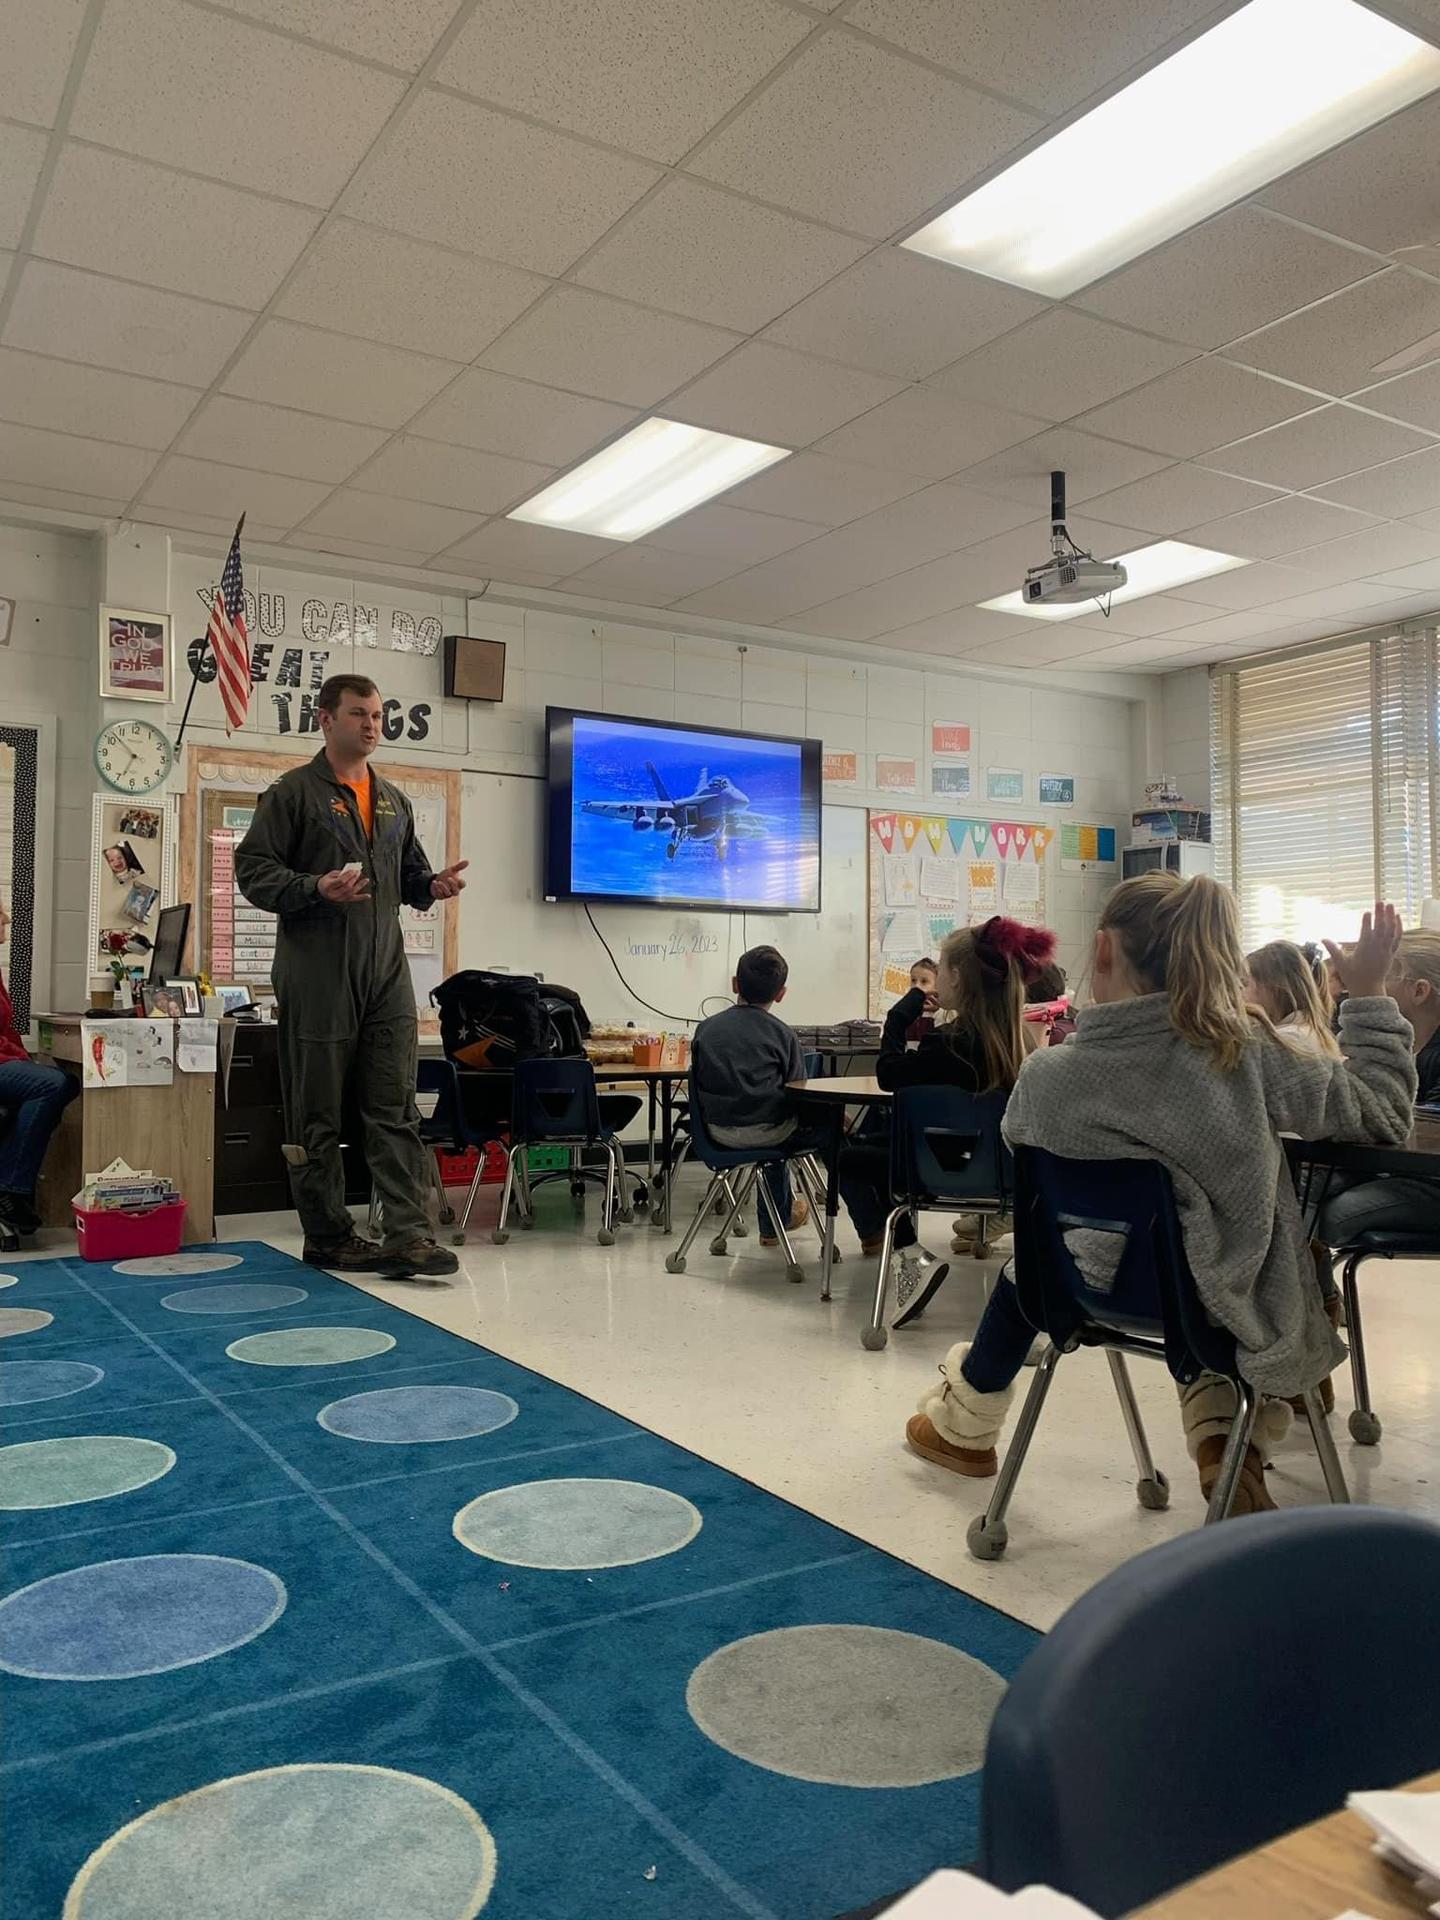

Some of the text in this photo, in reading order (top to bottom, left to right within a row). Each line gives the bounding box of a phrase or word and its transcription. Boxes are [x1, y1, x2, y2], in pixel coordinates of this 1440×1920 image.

[127, 622, 146, 638] IN
[302, 599, 378, 649] CAN
[391, 609, 443, 657] DO
[112, 633, 154, 651] GOD
[122, 648, 151, 665] WE
[187, 637, 330, 690] GEAT
[271, 691, 432, 742] THGS
[119, 728, 125, 737] 11
[132, 725, 140, 735] 12
[107, 736, 116, 746] 10
[156, 742, 163, 751] 2
[102, 748, 108, 757] 9
[160, 756, 166, 765] 3
[105, 762, 112, 771] 8
[115, 773, 122, 781] 7
[154, 769, 160, 777] 4
[129, 778, 135, 787] 6
[143, 776, 150, 785] 5
[623, 935, 667, 961] January
[691, 935, 719, 953] 2023
